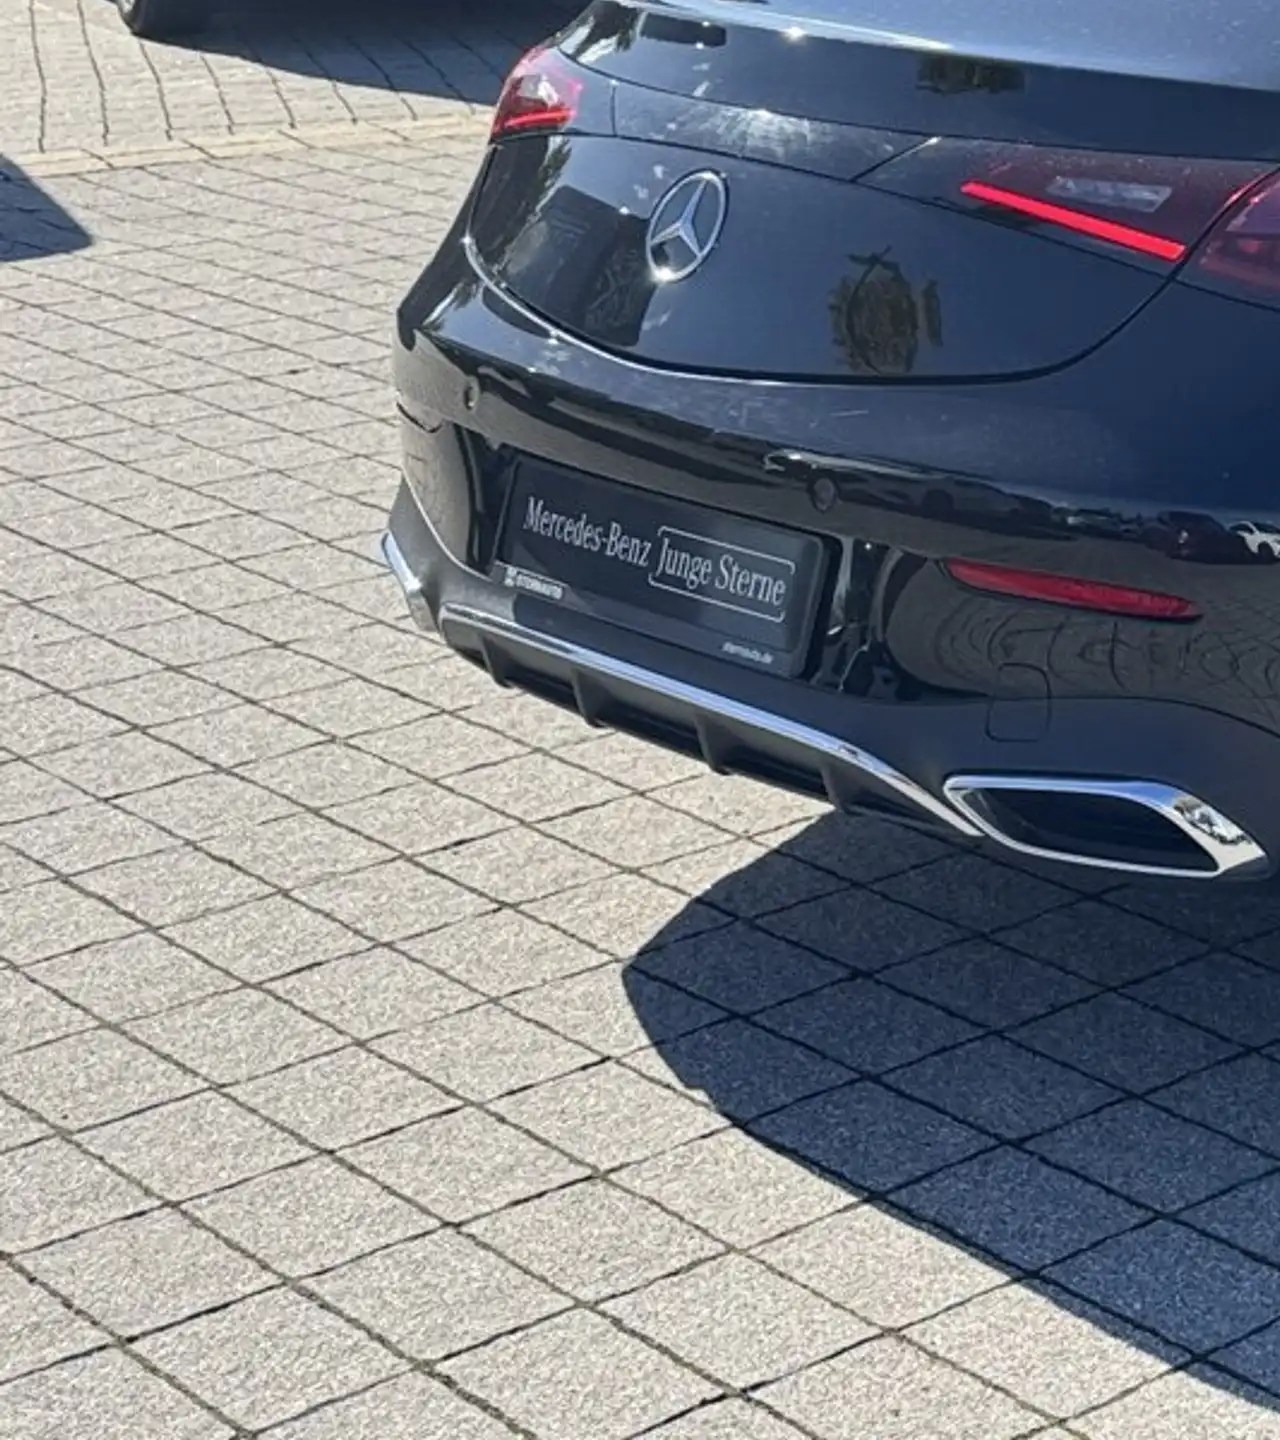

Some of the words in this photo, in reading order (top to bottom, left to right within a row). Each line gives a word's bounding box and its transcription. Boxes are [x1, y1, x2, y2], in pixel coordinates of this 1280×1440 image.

[523, 496, 651, 567] Mercedes-Benz
[655, 537, 712, 590] Junge
[714, 554, 786, 606] Sterne
